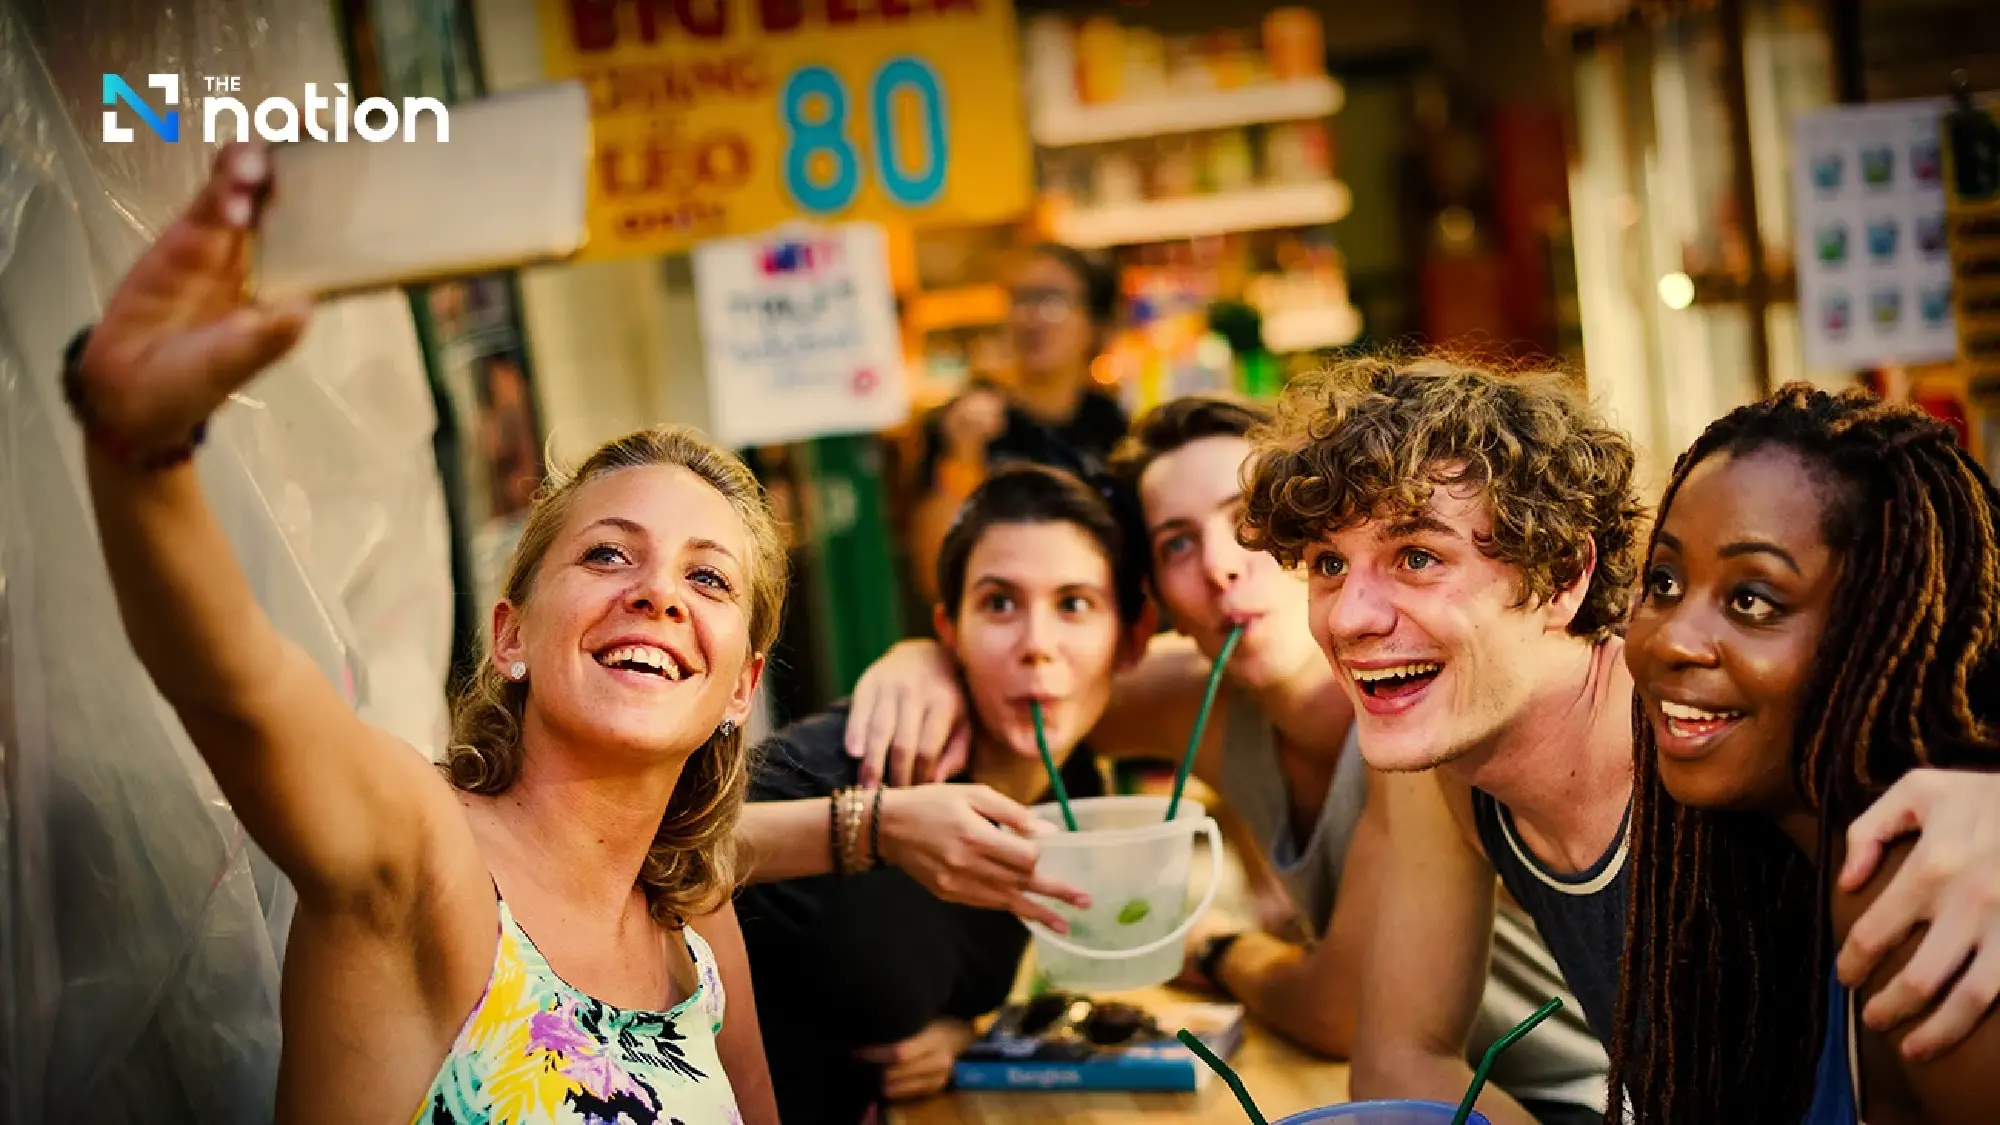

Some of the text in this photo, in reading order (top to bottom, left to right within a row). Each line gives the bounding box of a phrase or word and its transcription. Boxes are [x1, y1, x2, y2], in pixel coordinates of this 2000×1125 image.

[574, 0, 982, 51] BIG BE
[785, 60, 947, 211] 80
